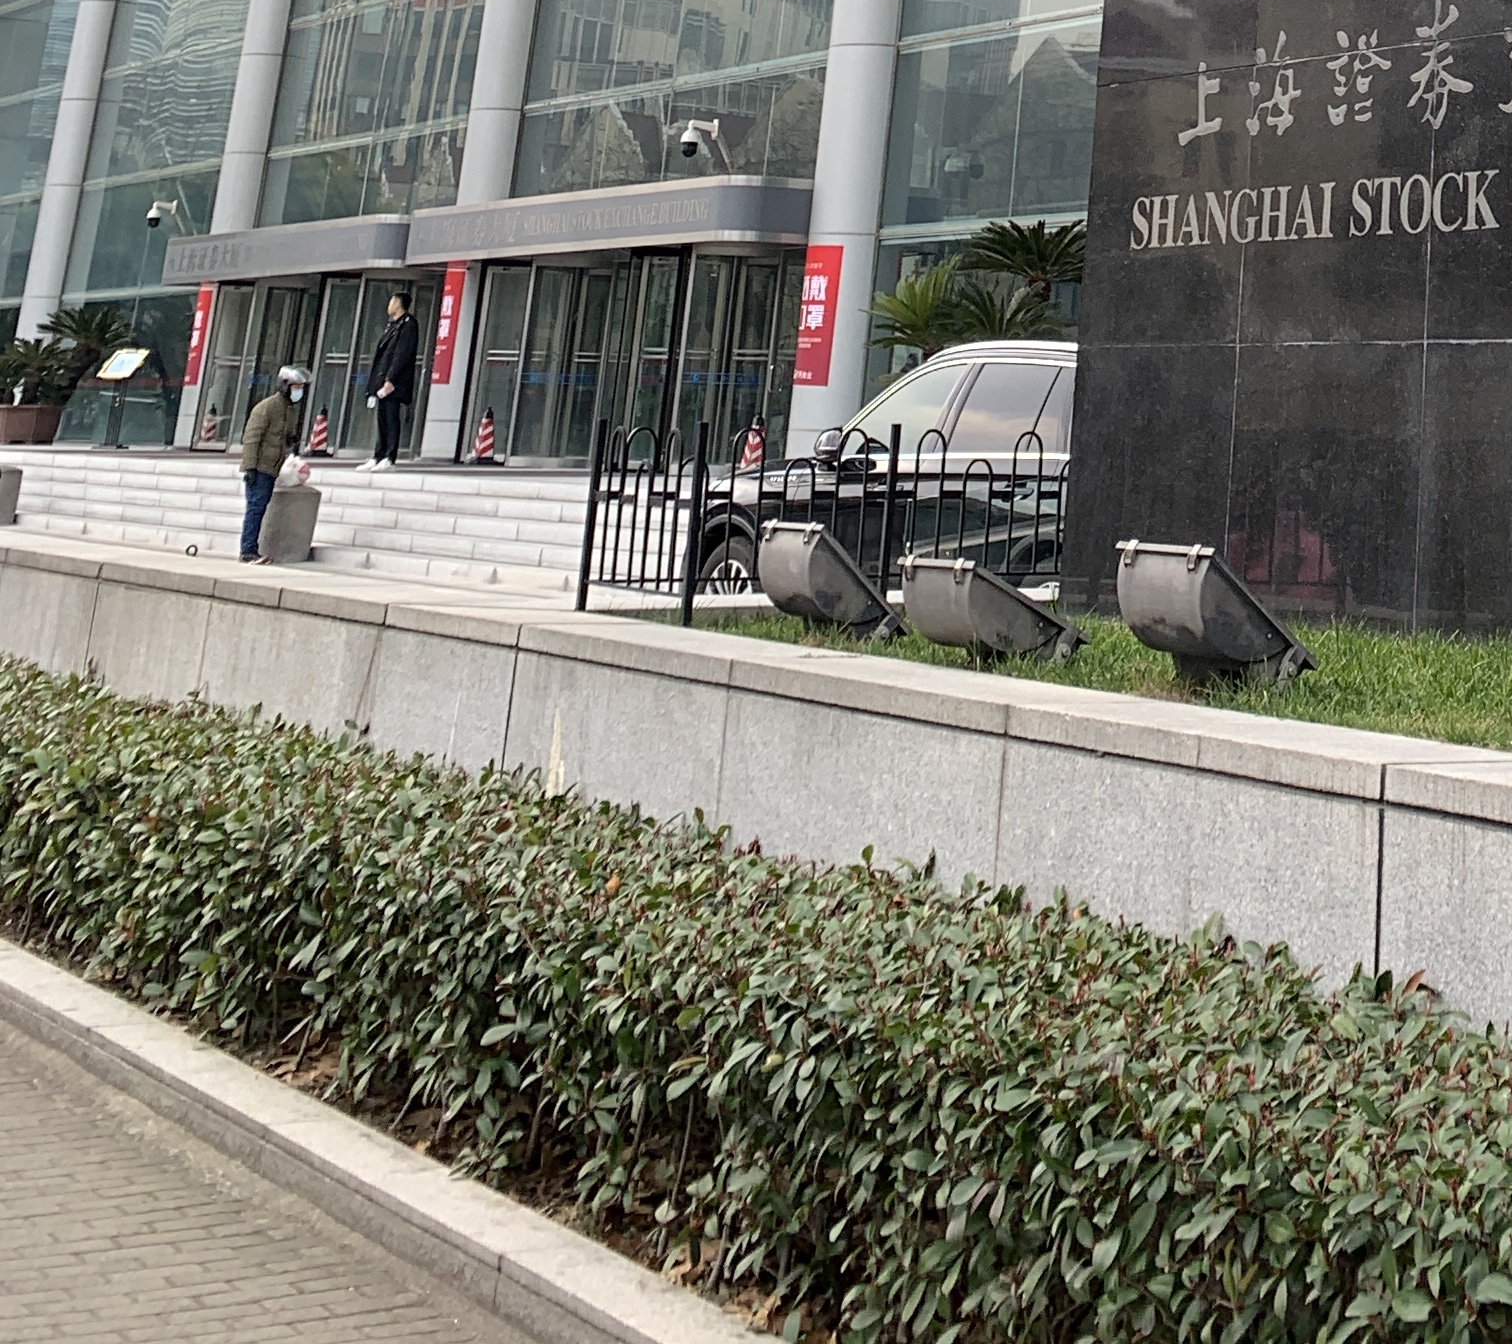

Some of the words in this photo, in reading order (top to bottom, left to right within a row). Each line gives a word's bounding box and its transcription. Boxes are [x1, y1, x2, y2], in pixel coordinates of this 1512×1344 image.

[603, 203, 658, 229] EXCHANGE
[658, 198, 710, 224] BUILDING
[1130, 181, 1337, 250] SHANGHAI
[1349, 169, 1500, 237] STOCK
